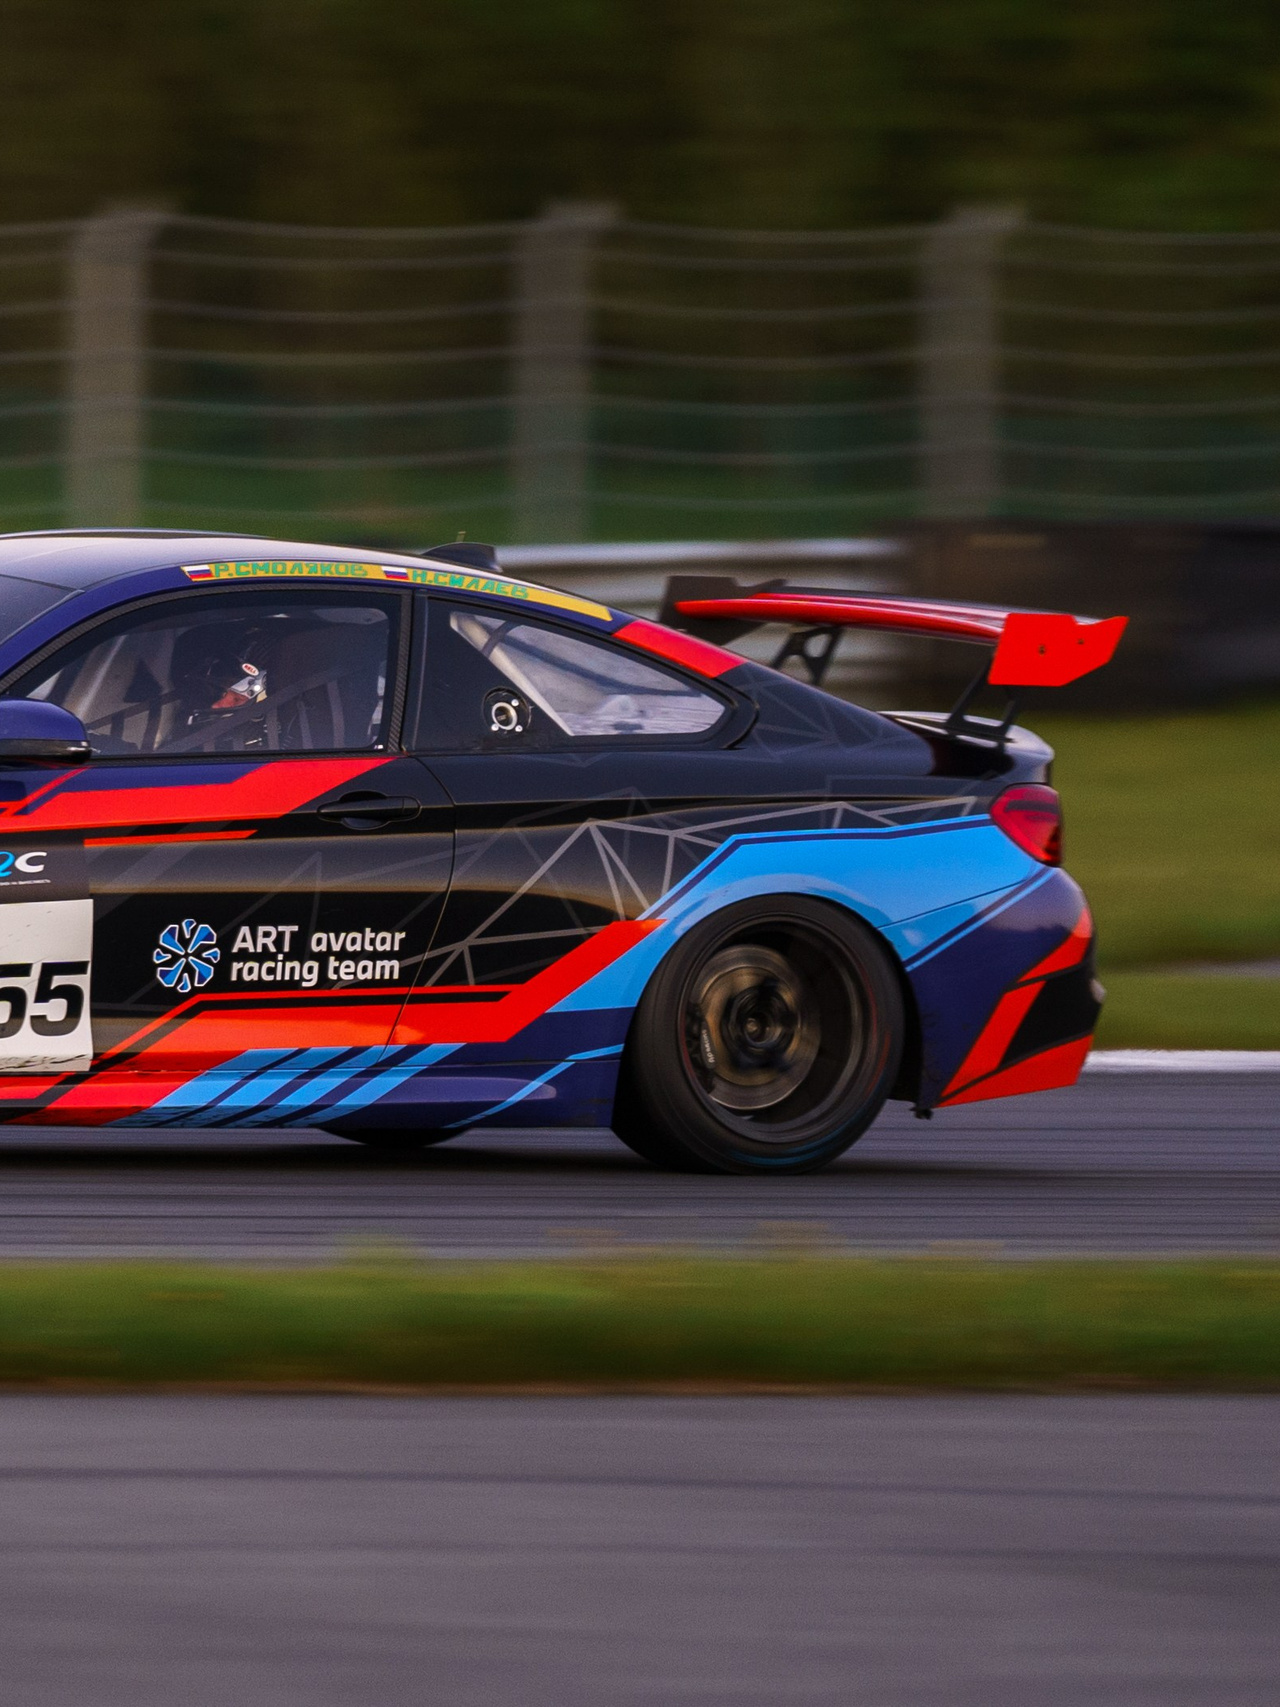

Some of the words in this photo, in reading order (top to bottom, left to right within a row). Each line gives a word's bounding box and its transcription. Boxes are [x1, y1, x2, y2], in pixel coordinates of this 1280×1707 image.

[231, 925, 299, 953] ART
[311, 927, 406, 953] avatar
[230, 956, 320, 987] racing
[327, 956, 400, 981] team
